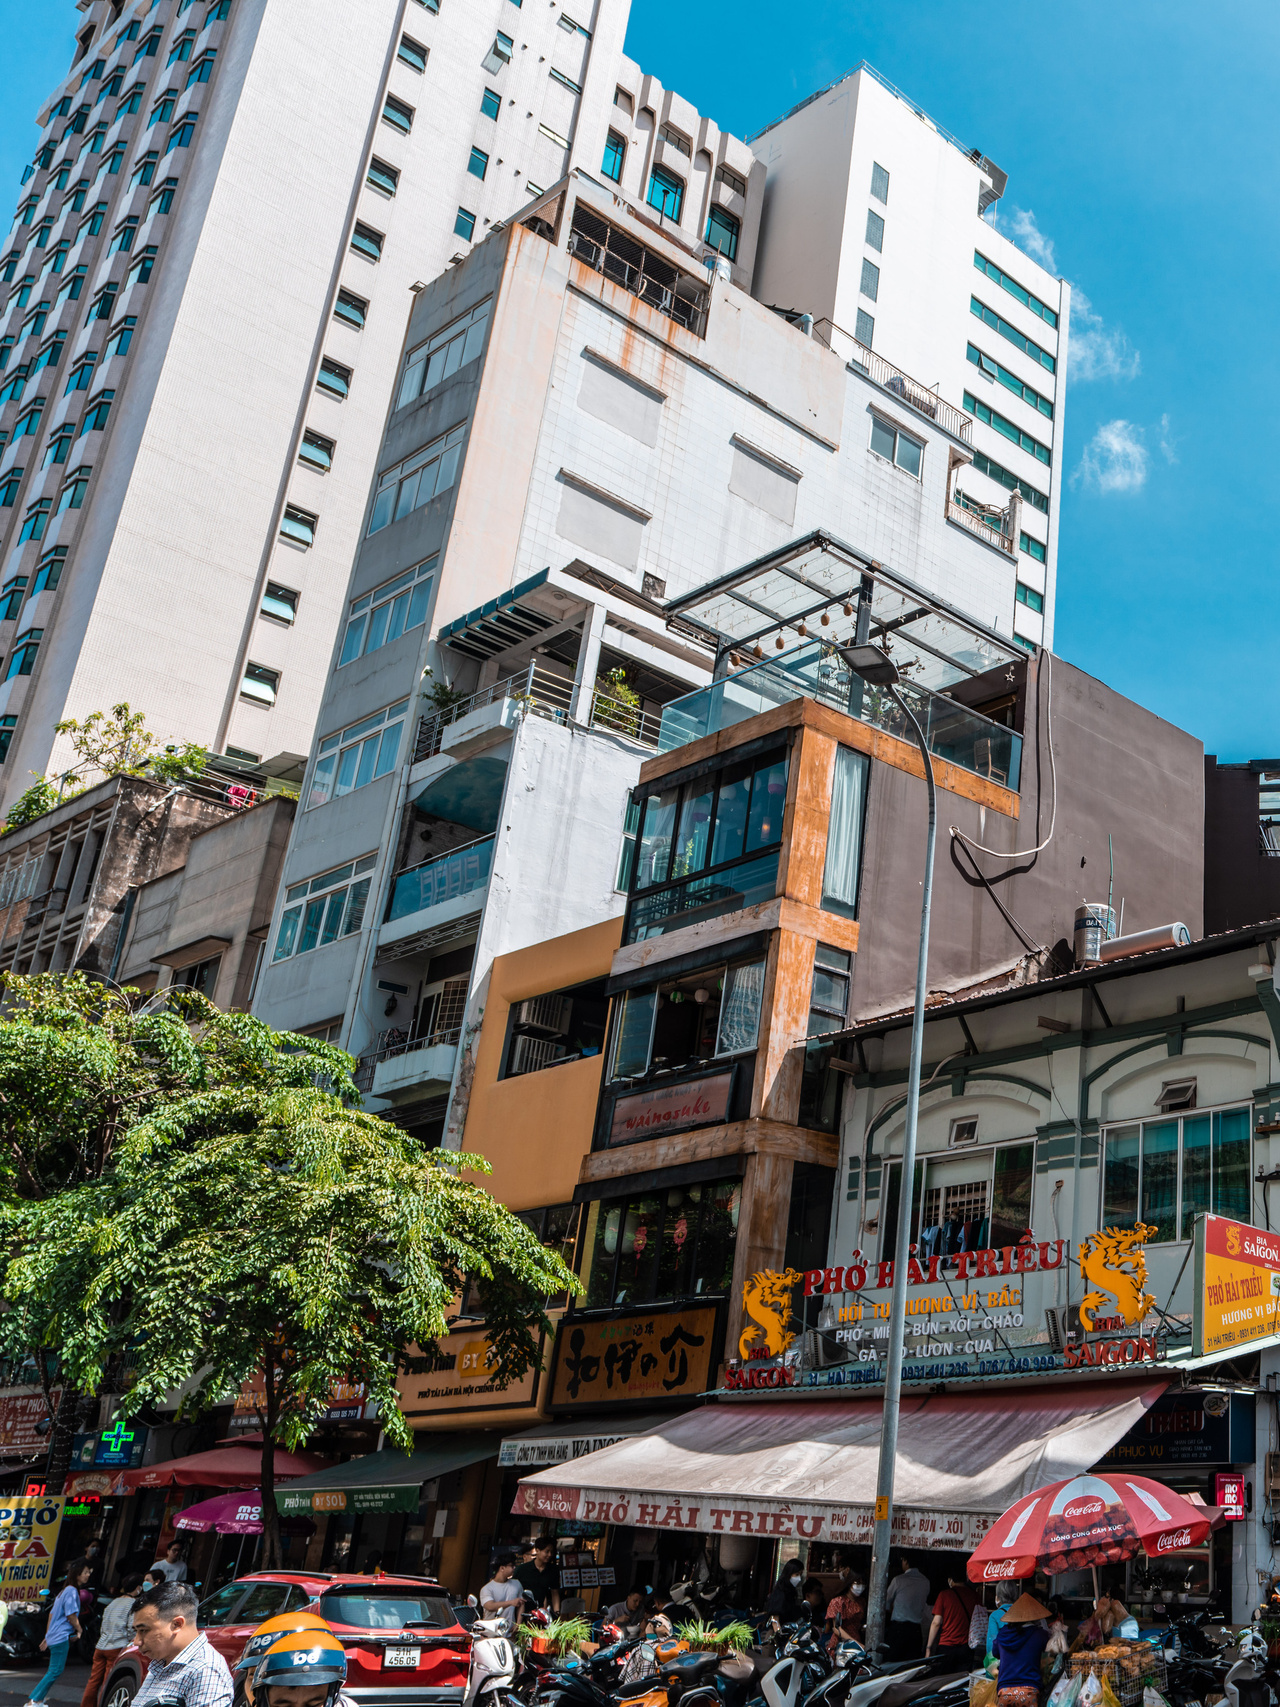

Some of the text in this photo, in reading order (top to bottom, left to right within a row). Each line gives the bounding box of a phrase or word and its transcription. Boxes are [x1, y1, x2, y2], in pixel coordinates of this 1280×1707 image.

[626, 1096, 711, 1130] wainosuke
[1244, 1240, 1279, 1262] SAIGON
[1256, 1236, 1268, 1247] BIA
[802, 1228, 1067, 1297] PHỞ HẢI TRIỀU
[1207, 1267, 1263, 1306] PHỞ HẢI TRIỀU
[871, 1302, 891, 1322] TỤ
[961, 1289, 979, 1315] VỊ
[986, 1282, 1022, 1309] BẮC
[912, 1316, 939, 1337] BÚN
[948, 1314, 970, 1332] XÔI
[983, 1310, 1024, 1331] CHÁO
[1095, 1315, 1125, 1332] BIA
[1221, 1307, 1253, 1326] HƯƠNG
[1254, 1304, 1264, 1318] VỊ
[749, 1347, 770, 1361] BIA
[858, 1339, 995, 1362] GÀ LƯƠN CUA
[1063, 1337, 1158, 1368] SAIGON
[462, 1353, 481, 1369] BY
[807, 1372, 819, 1386] 31
[849, 1364, 882, 1383] TRIỀU
[901, 1365, 927, 1380] 0931
[948, 1361, 970, 1376] 236
[979, 1359, 1006, 1374] 0767
[1008, 1356, 1031, 1372] 649
[1033, 1355, 1055, 1370] 999
[725, 1366, 796, 1390] SAIGON
[418, 1387, 431, 1399] PHỞ
[1118, 1444, 1164, 1460] PHỤC VỤ
[284, 1493, 299, 1509] PHỞ
[316, 1496, 324, 1506] BY
[326, 1495, 344, 1507] SOL
[536, 1498, 573, 1514] SAIGON
[552, 1493, 562, 1501] BIA
[0, 1499, 60, 1526] PHỞ
[583, 1494, 826, 1538] PHỞ HẢI TRIỀU
[877, 1504, 882, 1513] 3
[831, 1510, 848, 1527] PHỞ
[856, 1511, 875, 1528] CHÁ
[918, 1515, 937, 1533] BÚN
[944, 1516, 964, 1535] XÔI
[10, 1559, 35, 1581] TRIỀU
[3, 1587, 26, 1602] SANG
[251, 1634, 272, 1650] be
[396, 1647, 412, 1656] 51H
[293, 1650, 321, 1666] be
[388, 1656, 417, 1665] 456.05
